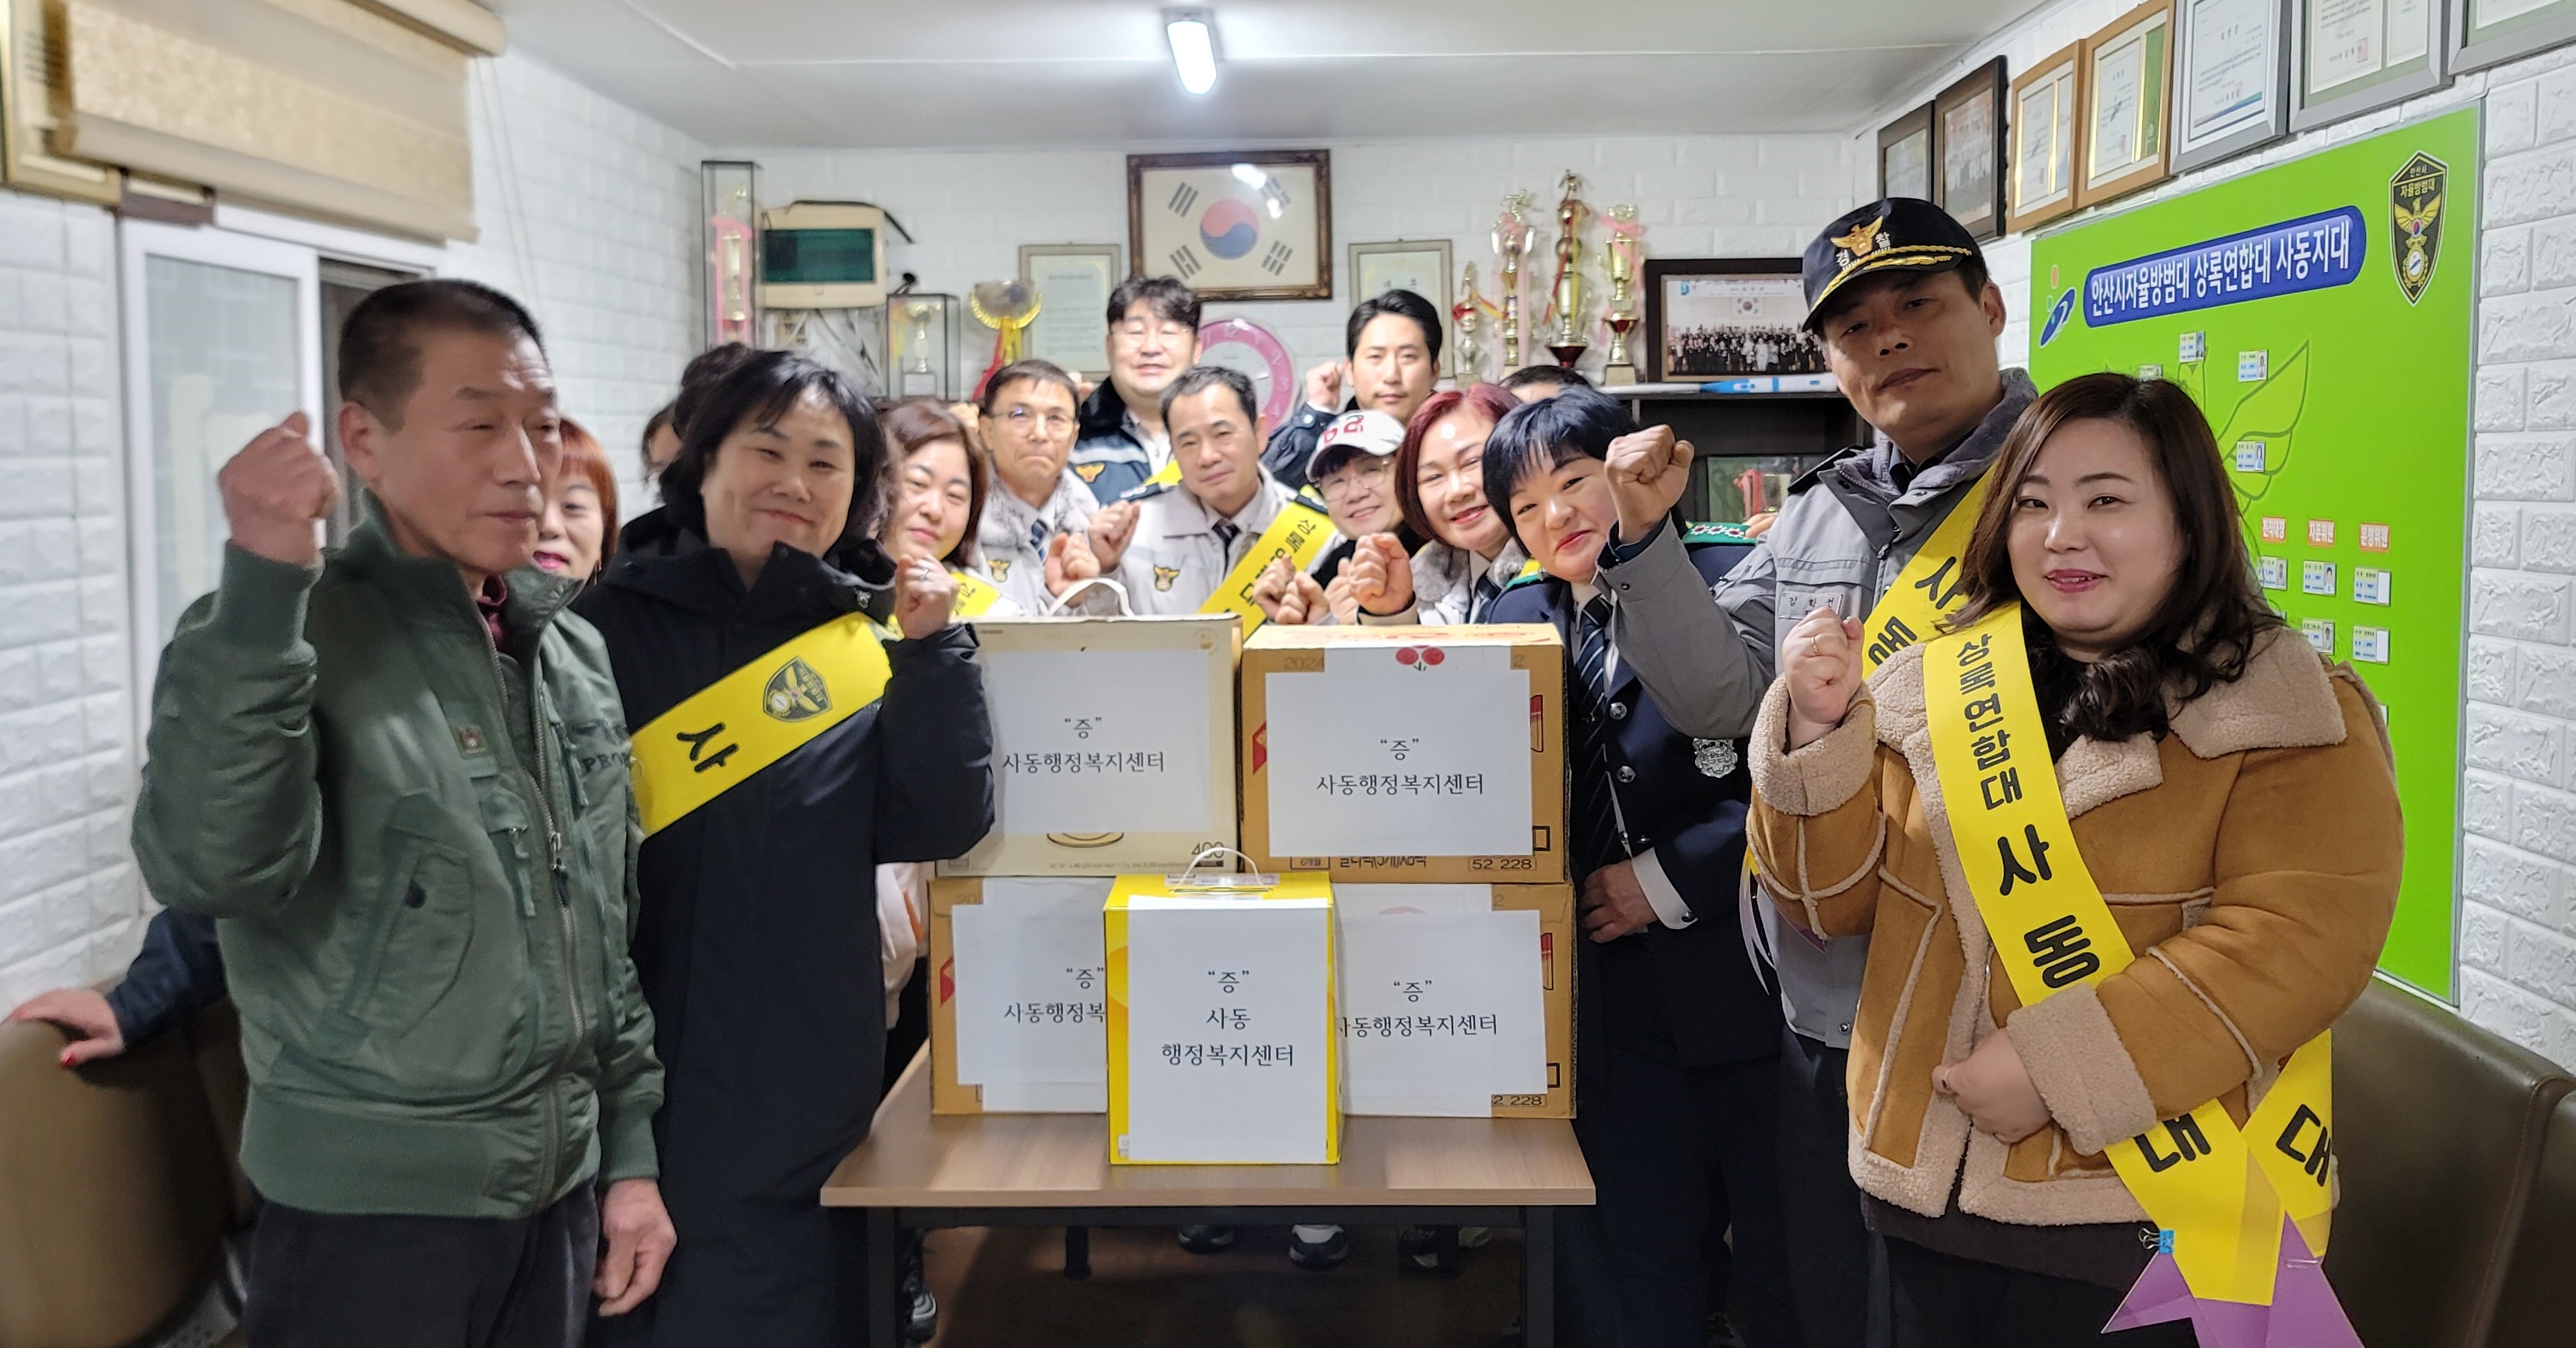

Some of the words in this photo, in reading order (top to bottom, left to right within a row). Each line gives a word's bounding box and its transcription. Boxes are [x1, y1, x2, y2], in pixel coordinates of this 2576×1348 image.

[2400, 179, 2436, 199] 자율방범대
[2091, 258, 2190, 317] 안산시자율방범대
[2193, 237, 2271, 299] 상록연합대
[2276, 221, 2351, 281] 사동지대
[2309, 522, 2333, 543] 자문위원
[2361, 526, 2388, 548] 운영위원
[1284, 657, 1325, 672] 2024
[1956, 634, 2023, 810] 상록연합대
[1002, 751, 1165, 774] 사동행정복지센터
[1316, 773, 1484, 796] 사동행정복지센터
[1472, 857, 1494, 870] 52
[1500, 857, 1533, 870] 228
[1206, 1008, 1251, 1030] 사동
[1162, 1042, 1294, 1067] 행정복지센터
[1510, 1095, 1543, 1105] 228
